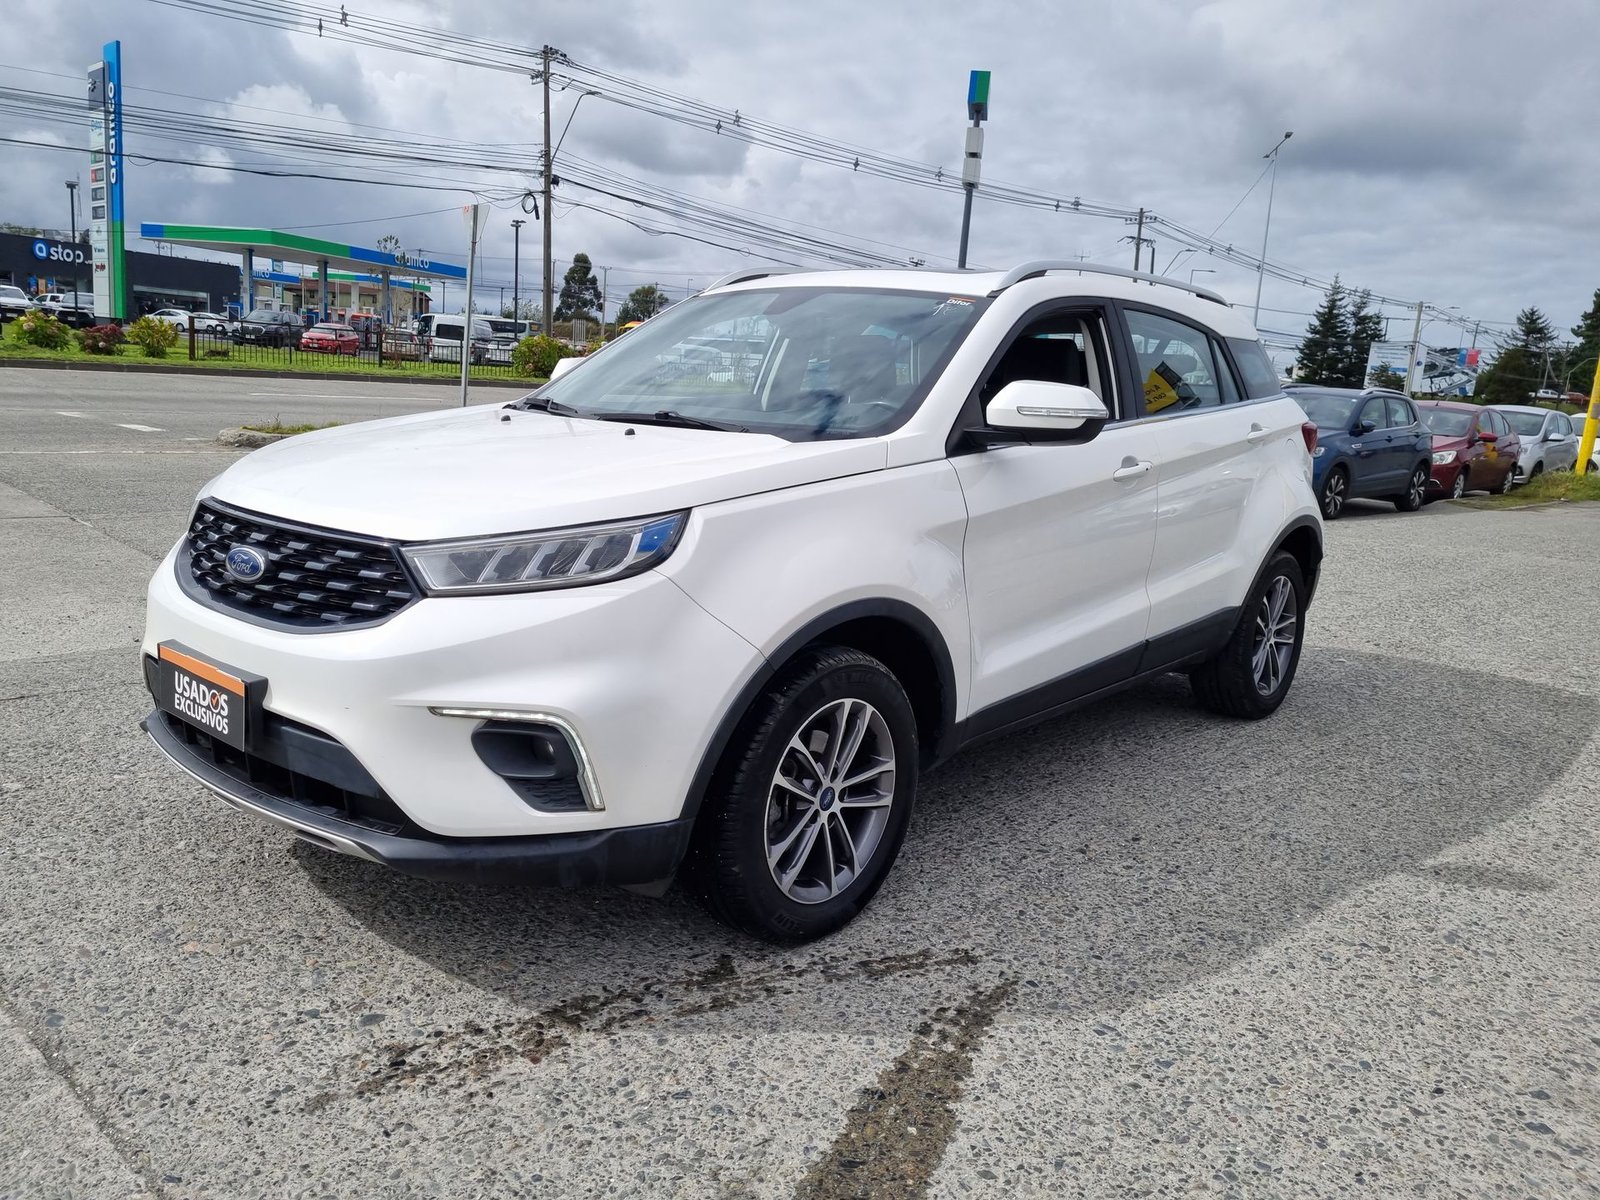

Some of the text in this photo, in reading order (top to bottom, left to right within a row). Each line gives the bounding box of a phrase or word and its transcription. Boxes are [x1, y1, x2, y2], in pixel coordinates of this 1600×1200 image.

[107, 82, 117, 184] aramco
[49, 244, 84, 265] stop
[946, 298, 972, 306] Difor
[231, 552, 253, 574] Ford
[174, 671, 229, 717] USADOS
[174, 693, 229, 735] EXCLUSIVOS
